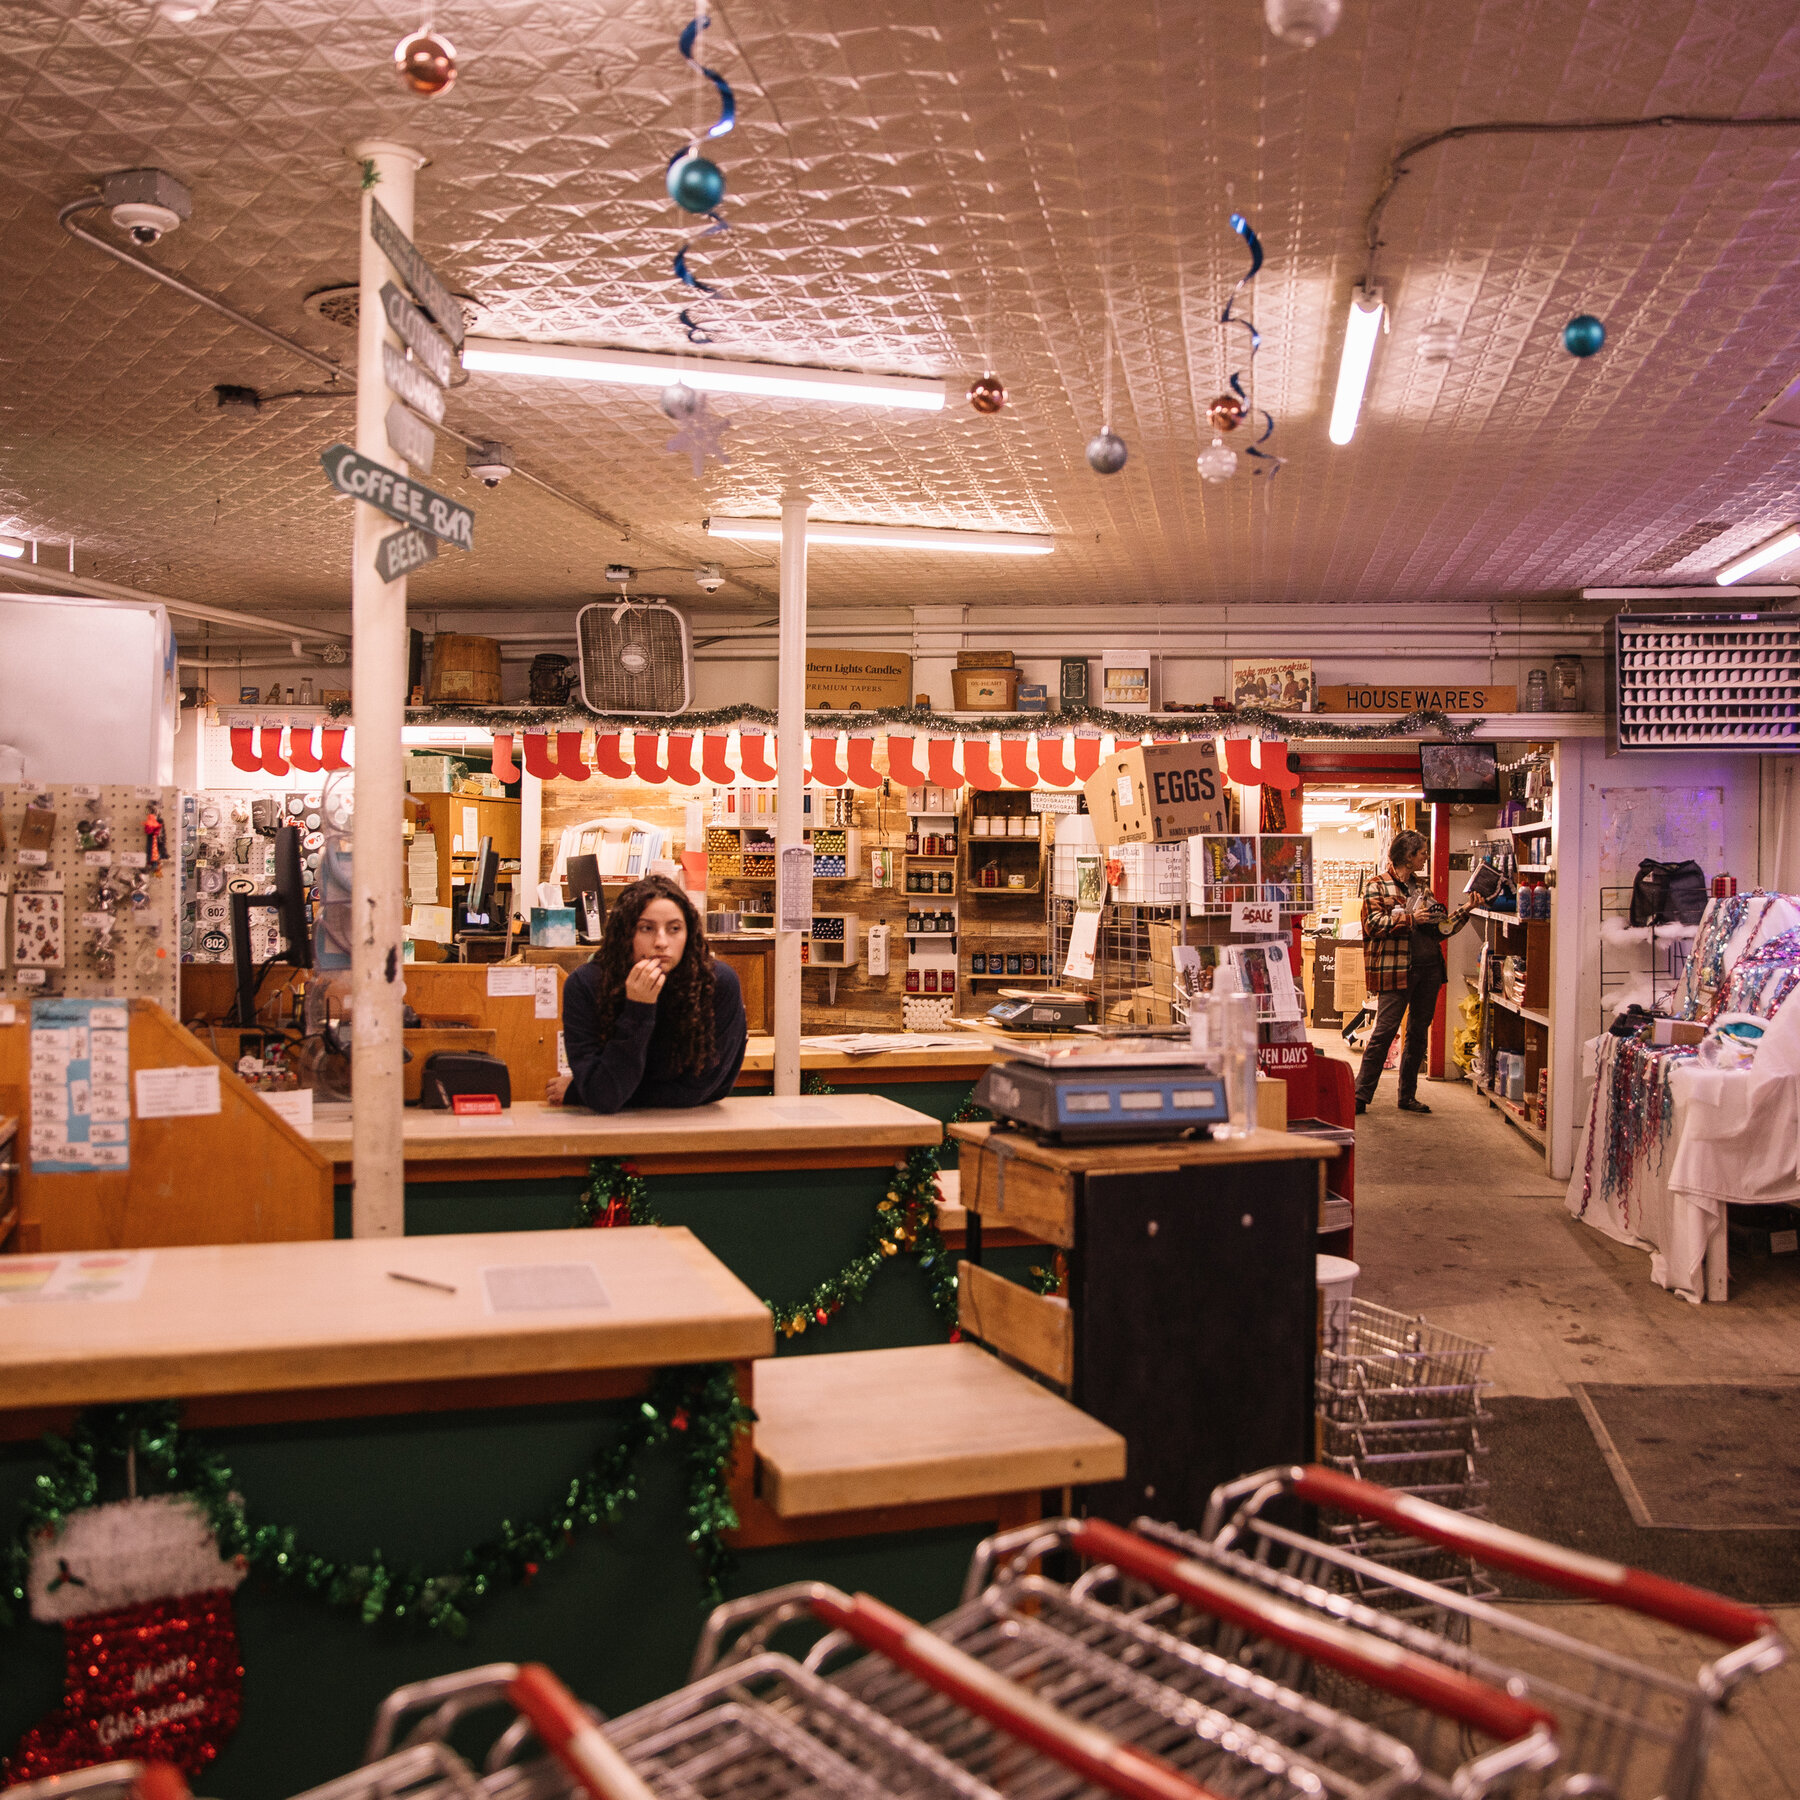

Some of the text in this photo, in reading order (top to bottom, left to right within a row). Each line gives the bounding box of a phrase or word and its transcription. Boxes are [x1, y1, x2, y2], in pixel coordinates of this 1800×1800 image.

[336, 454, 474, 552] COFFEE BAR
[387, 530, 429, 576] BEER
[806, 662, 902, 675] thern Lights Candles
[1234, 667, 1256, 678] make
[1258, 667, 1277, 675] more
[1347, 690, 1484, 708] HOUSEWARES
[1153, 768, 1216, 804] EGGS
[1169, 824, 1211, 836] HANDLE WITH CARE
[1294, 845, 1302, 867] living
[207, 907, 225, 917] 802
[1249, 908, 1273, 924] SALE
[205, 937, 225, 948] 802
[1257, 1047, 1308, 1064] VEN DAYS
